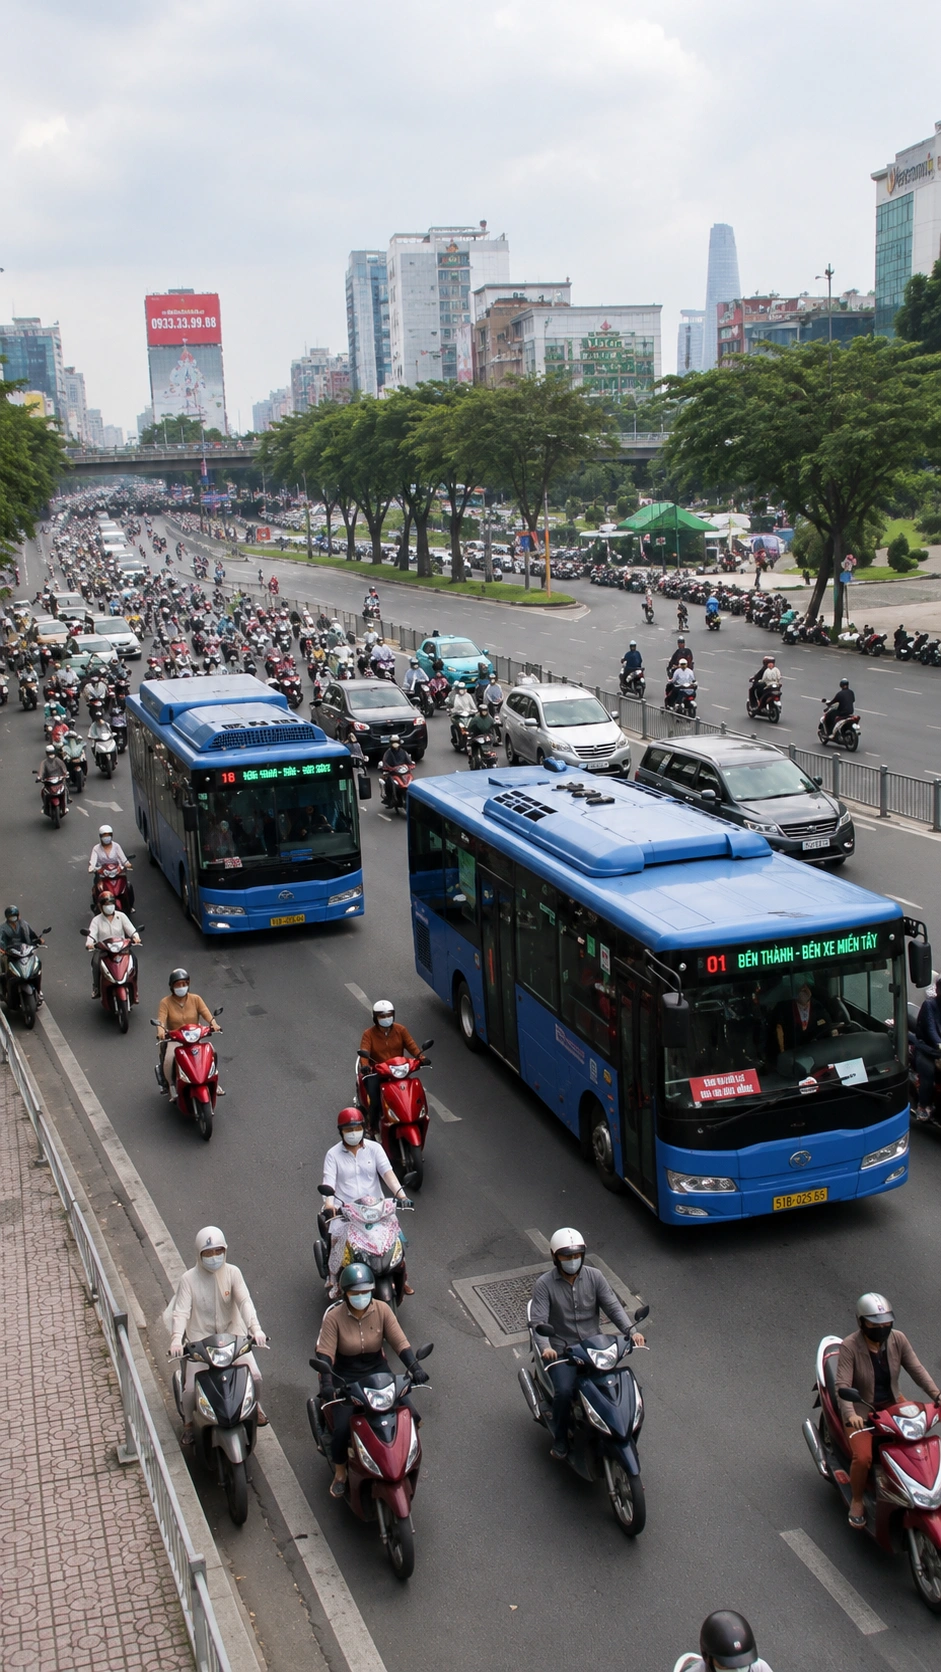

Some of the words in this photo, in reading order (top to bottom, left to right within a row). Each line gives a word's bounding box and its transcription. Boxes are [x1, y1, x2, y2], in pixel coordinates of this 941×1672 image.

[221, 772, 236, 784] 18
[707, 954, 726, 973] 01
[760, 944, 794, 965] THÀNH
[823, 940, 836, 957] XE
[860, 931, 878, 950] TÂY
